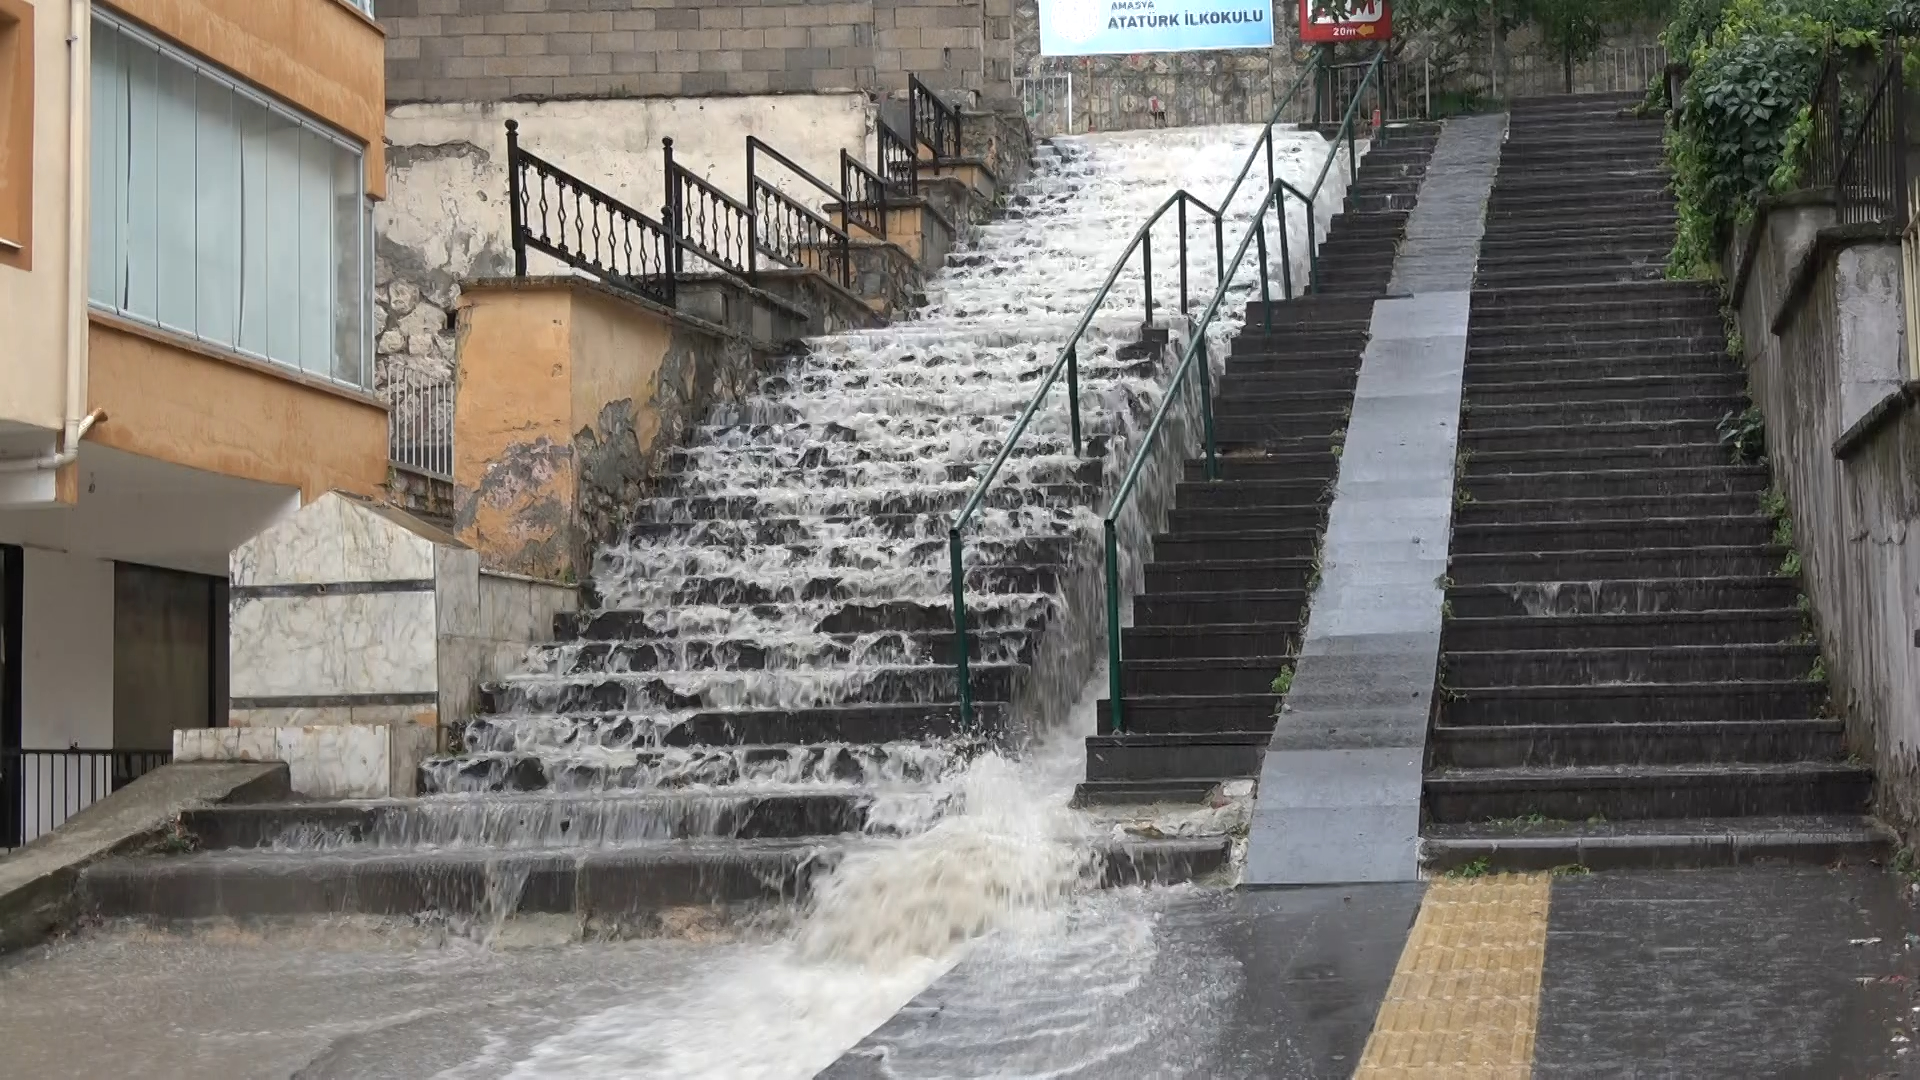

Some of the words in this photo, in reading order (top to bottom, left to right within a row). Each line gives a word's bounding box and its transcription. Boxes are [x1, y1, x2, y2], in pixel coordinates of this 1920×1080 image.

[1111, 1, 1155, 10] AMASYA
[1108, 12, 1180, 29] ATATÜRK
[1185, 9, 1264, 26] İLKOKULU
[1332, 27, 1356, 36] 20m
